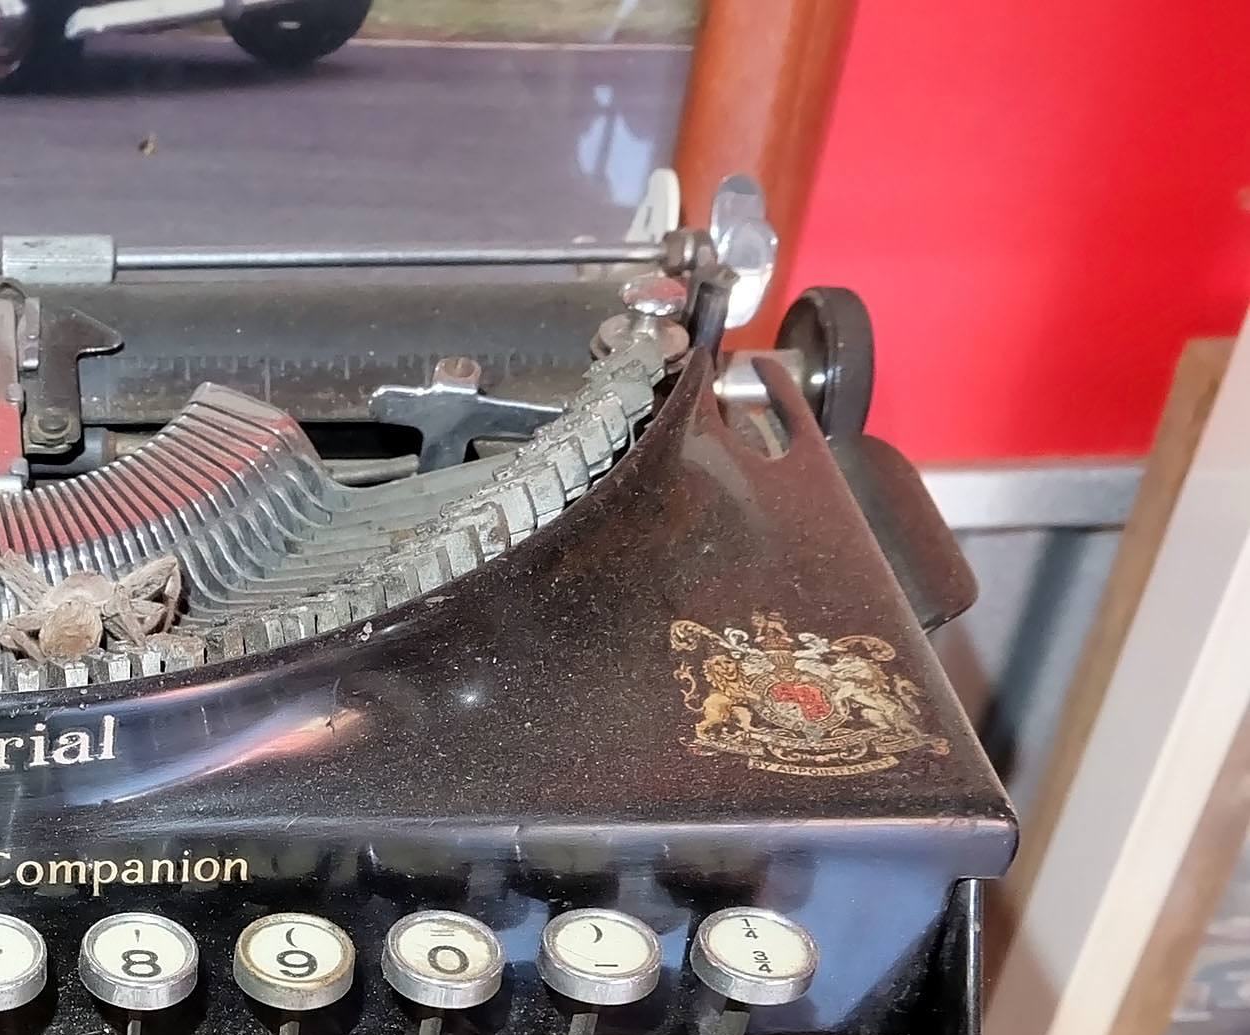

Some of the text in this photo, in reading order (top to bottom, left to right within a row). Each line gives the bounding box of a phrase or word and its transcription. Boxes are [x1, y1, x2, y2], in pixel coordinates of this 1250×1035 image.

[777, 756, 893, 775] APPOINTMENT
[121, 950, 161, 977] 8
[276, 951, 317, 977] 9
